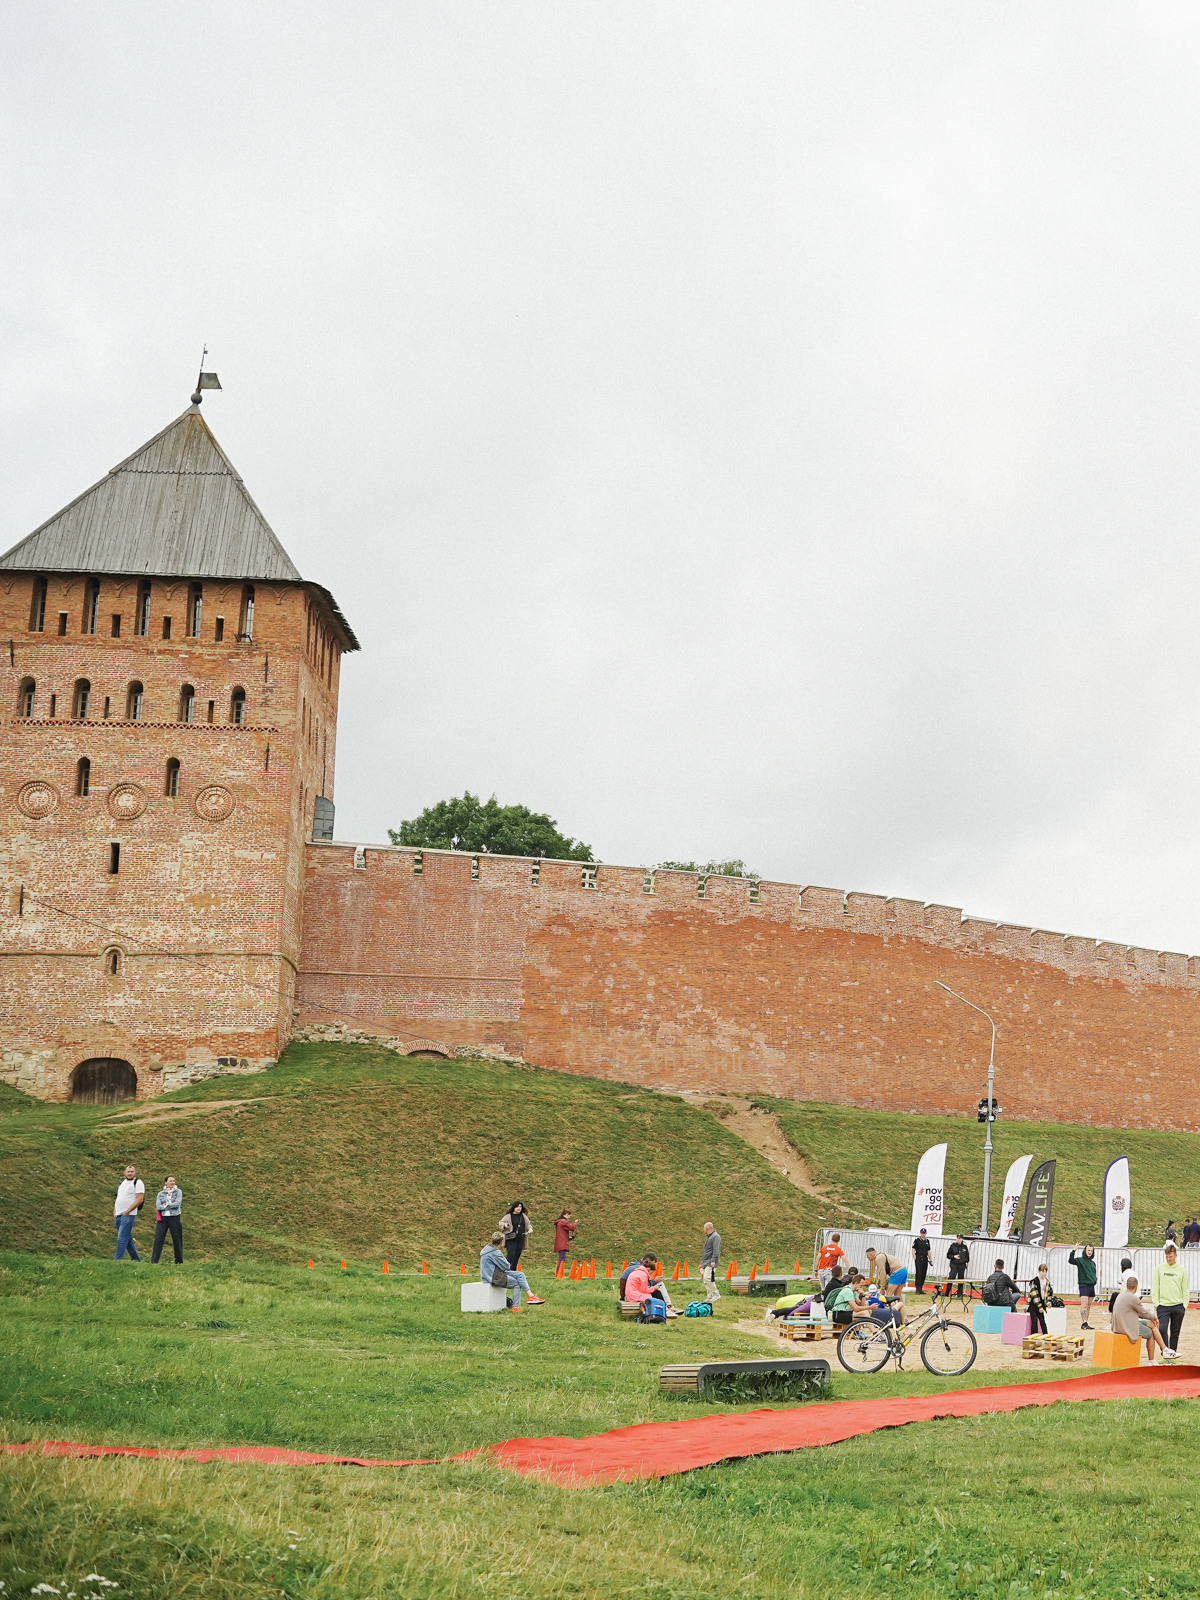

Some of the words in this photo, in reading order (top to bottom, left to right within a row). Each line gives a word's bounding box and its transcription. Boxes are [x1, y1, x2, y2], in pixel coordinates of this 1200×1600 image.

[918, 1187, 942, 1195] #nov
[1034, 1172, 1050, 1209] LIFE
[929, 1195, 942, 1204] go
[925, 1202, 941, 1211] rod
[923, 1212, 942, 1222] TRI
